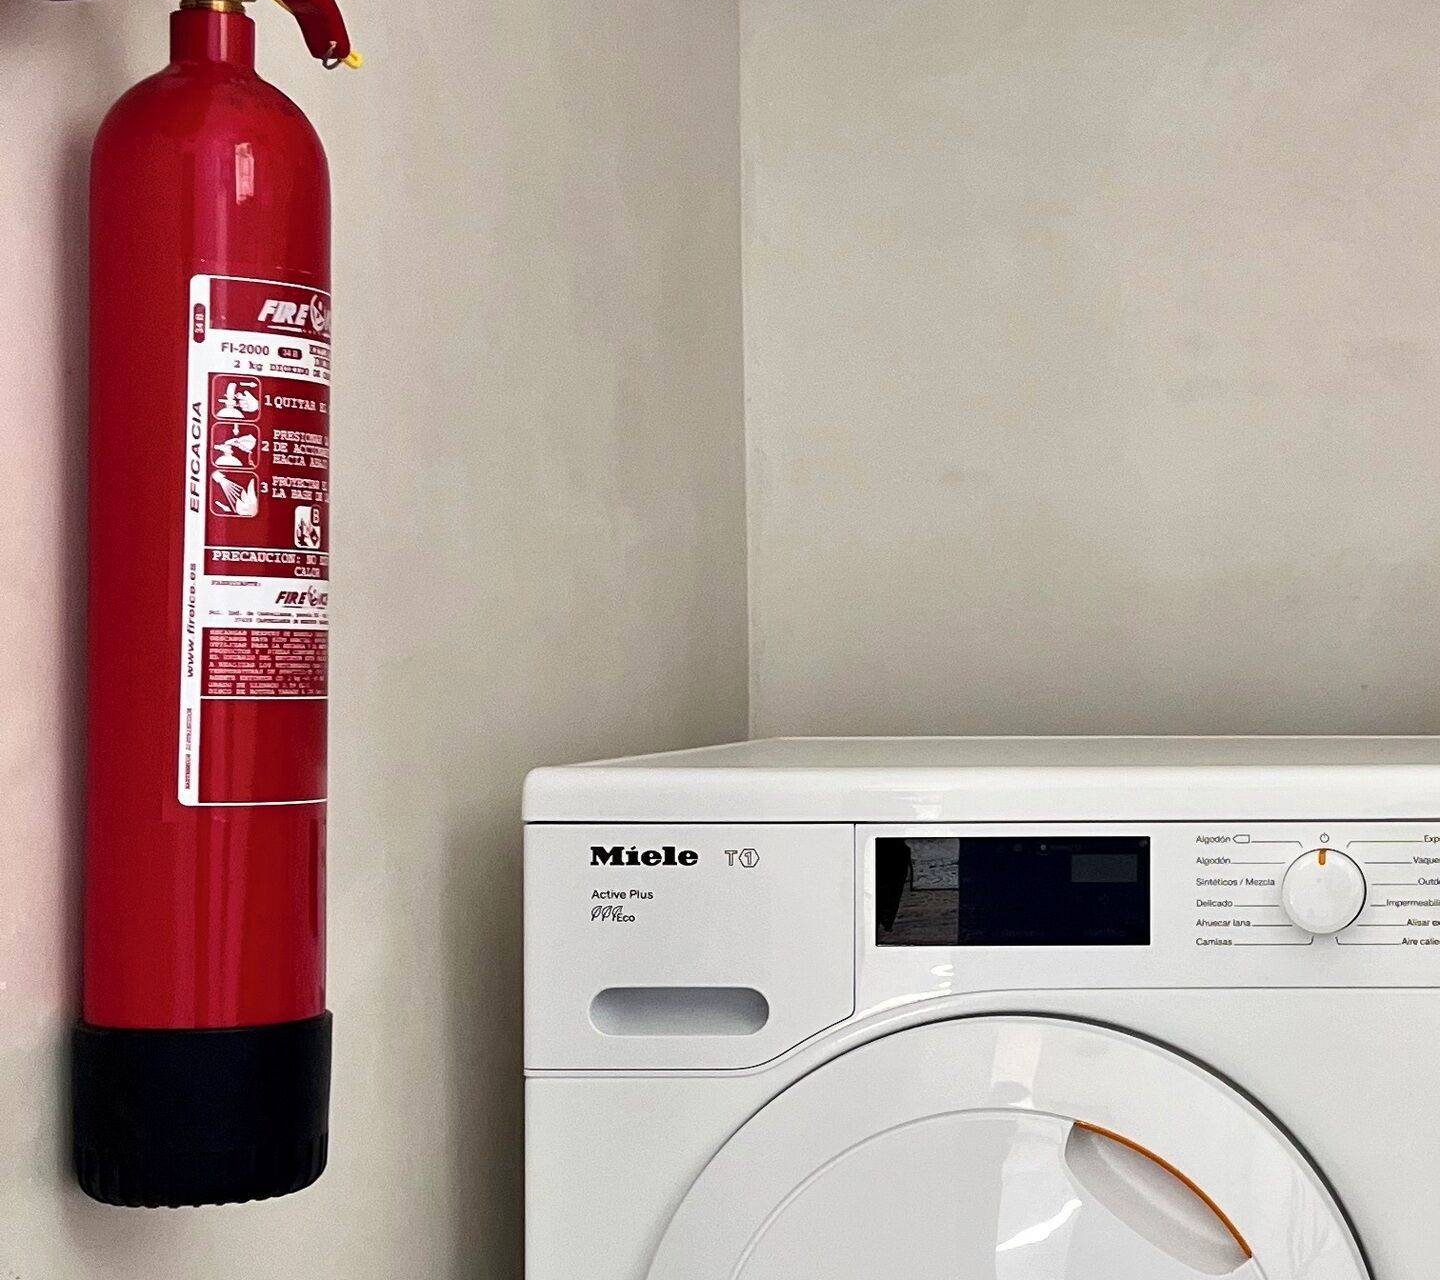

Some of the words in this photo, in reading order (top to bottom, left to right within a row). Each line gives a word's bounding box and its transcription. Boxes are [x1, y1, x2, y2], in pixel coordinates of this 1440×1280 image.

[257, 299, 310, 327] FIRE
[221, 342, 270, 356] FI-2000
[234, 361, 241, 369] 2
[249, 361, 264, 371] kg
[264, 395, 272, 407] 1
[261, 441, 270, 452] 2
[273, 442, 288, 453] DE
[190, 401, 202, 513] EFICACIA
[261, 482, 268, 493] 3
[212, 551, 301, 564] PRECAUCION:
[275, 591, 307, 605] FIRE
[1195, 835, 1232, 845] Algodón
[590, 845, 699, 867] Miele
[1195, 856, 1232, 866] Algodón
[1195, 877, 1237, 887] Sintéticos
[1246, 877, 1276, 887] Mezcla
[591, 889, 627, 900] Active
[629, 889, 654, 900] Plus
[1196, 898, 1234, 908] Delicado
[616, 913, 636, 923] Eco
[1196, 918, 1230, 928] Ahuecar
[1232, 918, 1252, 928] lana
[1406, 918, 1430, 928] Alisar
[1196, 937, 1233, 947] Camisas
[1402, 937, 1420, 946] Aire
